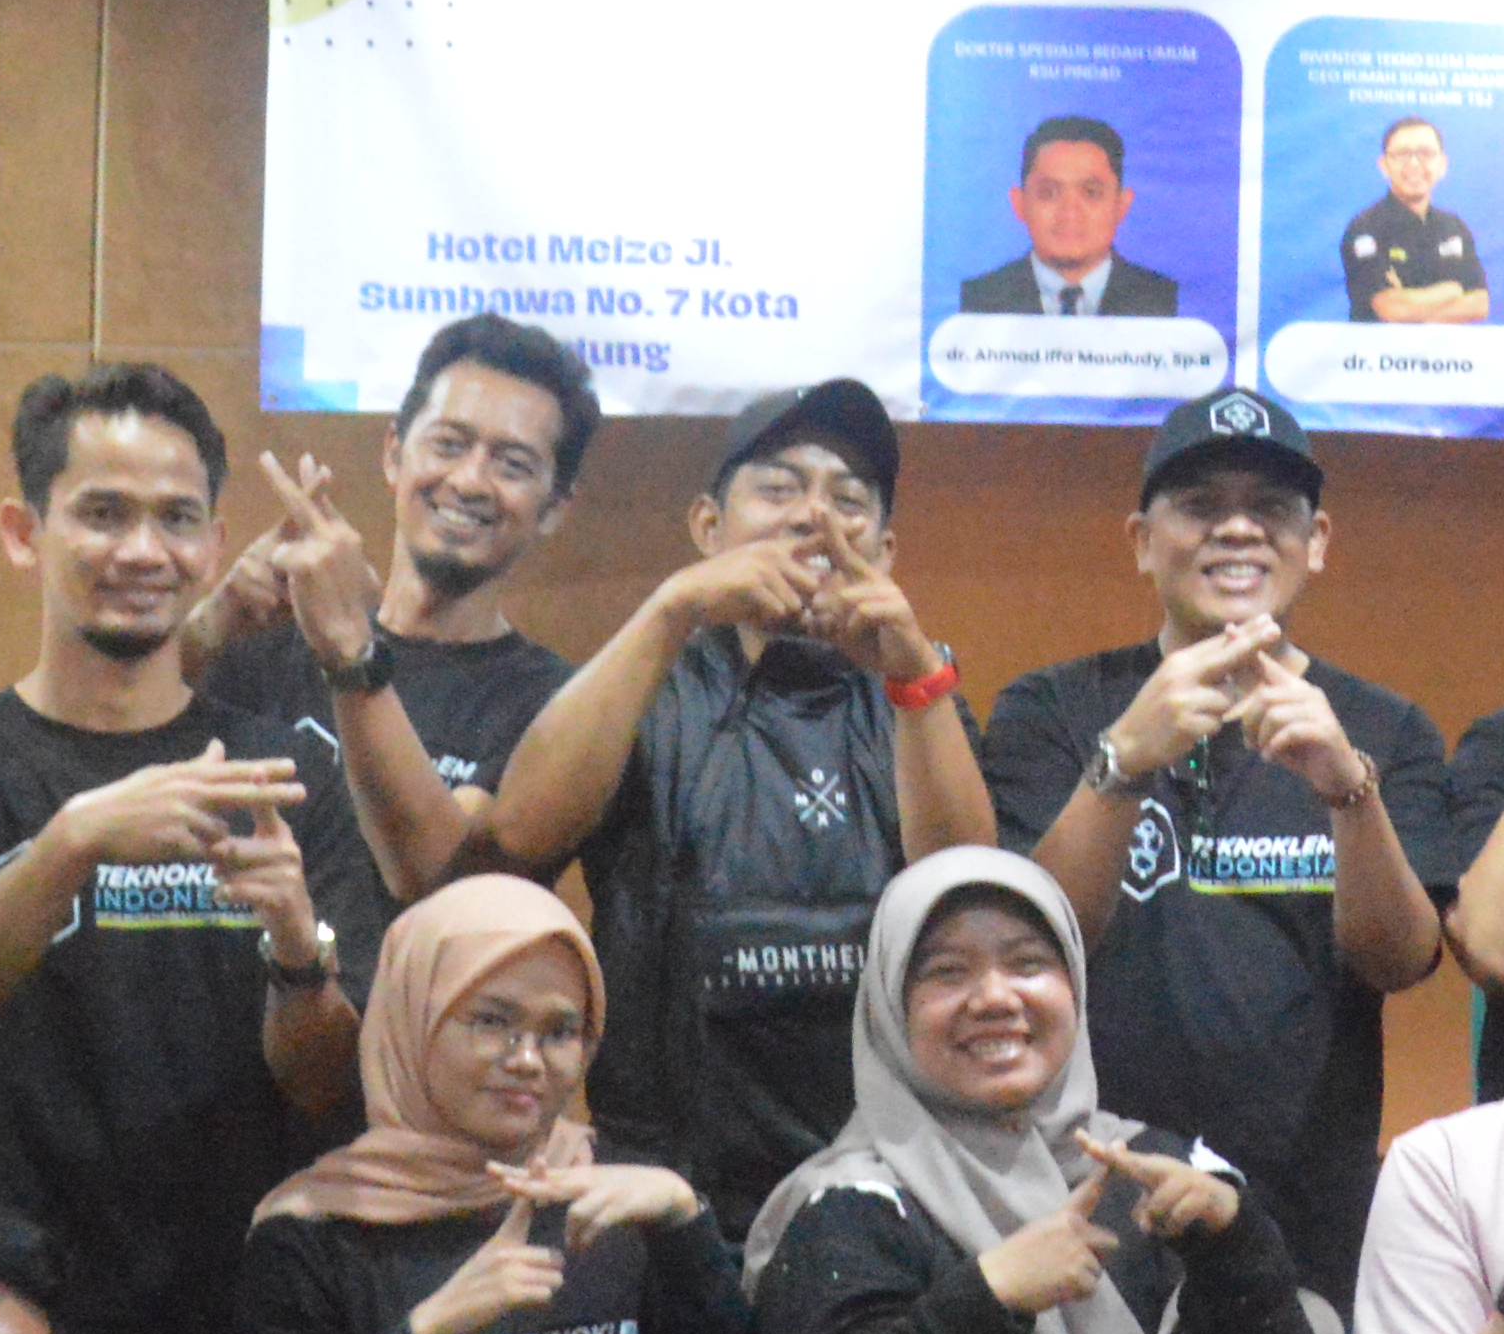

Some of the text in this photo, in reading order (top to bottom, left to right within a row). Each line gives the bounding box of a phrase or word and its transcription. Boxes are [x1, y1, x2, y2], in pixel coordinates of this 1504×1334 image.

[427, 233, 537, 264] Hotel
[358, 282, 799, 320] Sumbawa No. 7 Kota
[975, 347, 1040, 364] Ahmad
[1343, 353, 1474, 374] dr. Darsono
[96, 862, 220, 888] TEKNOKL
